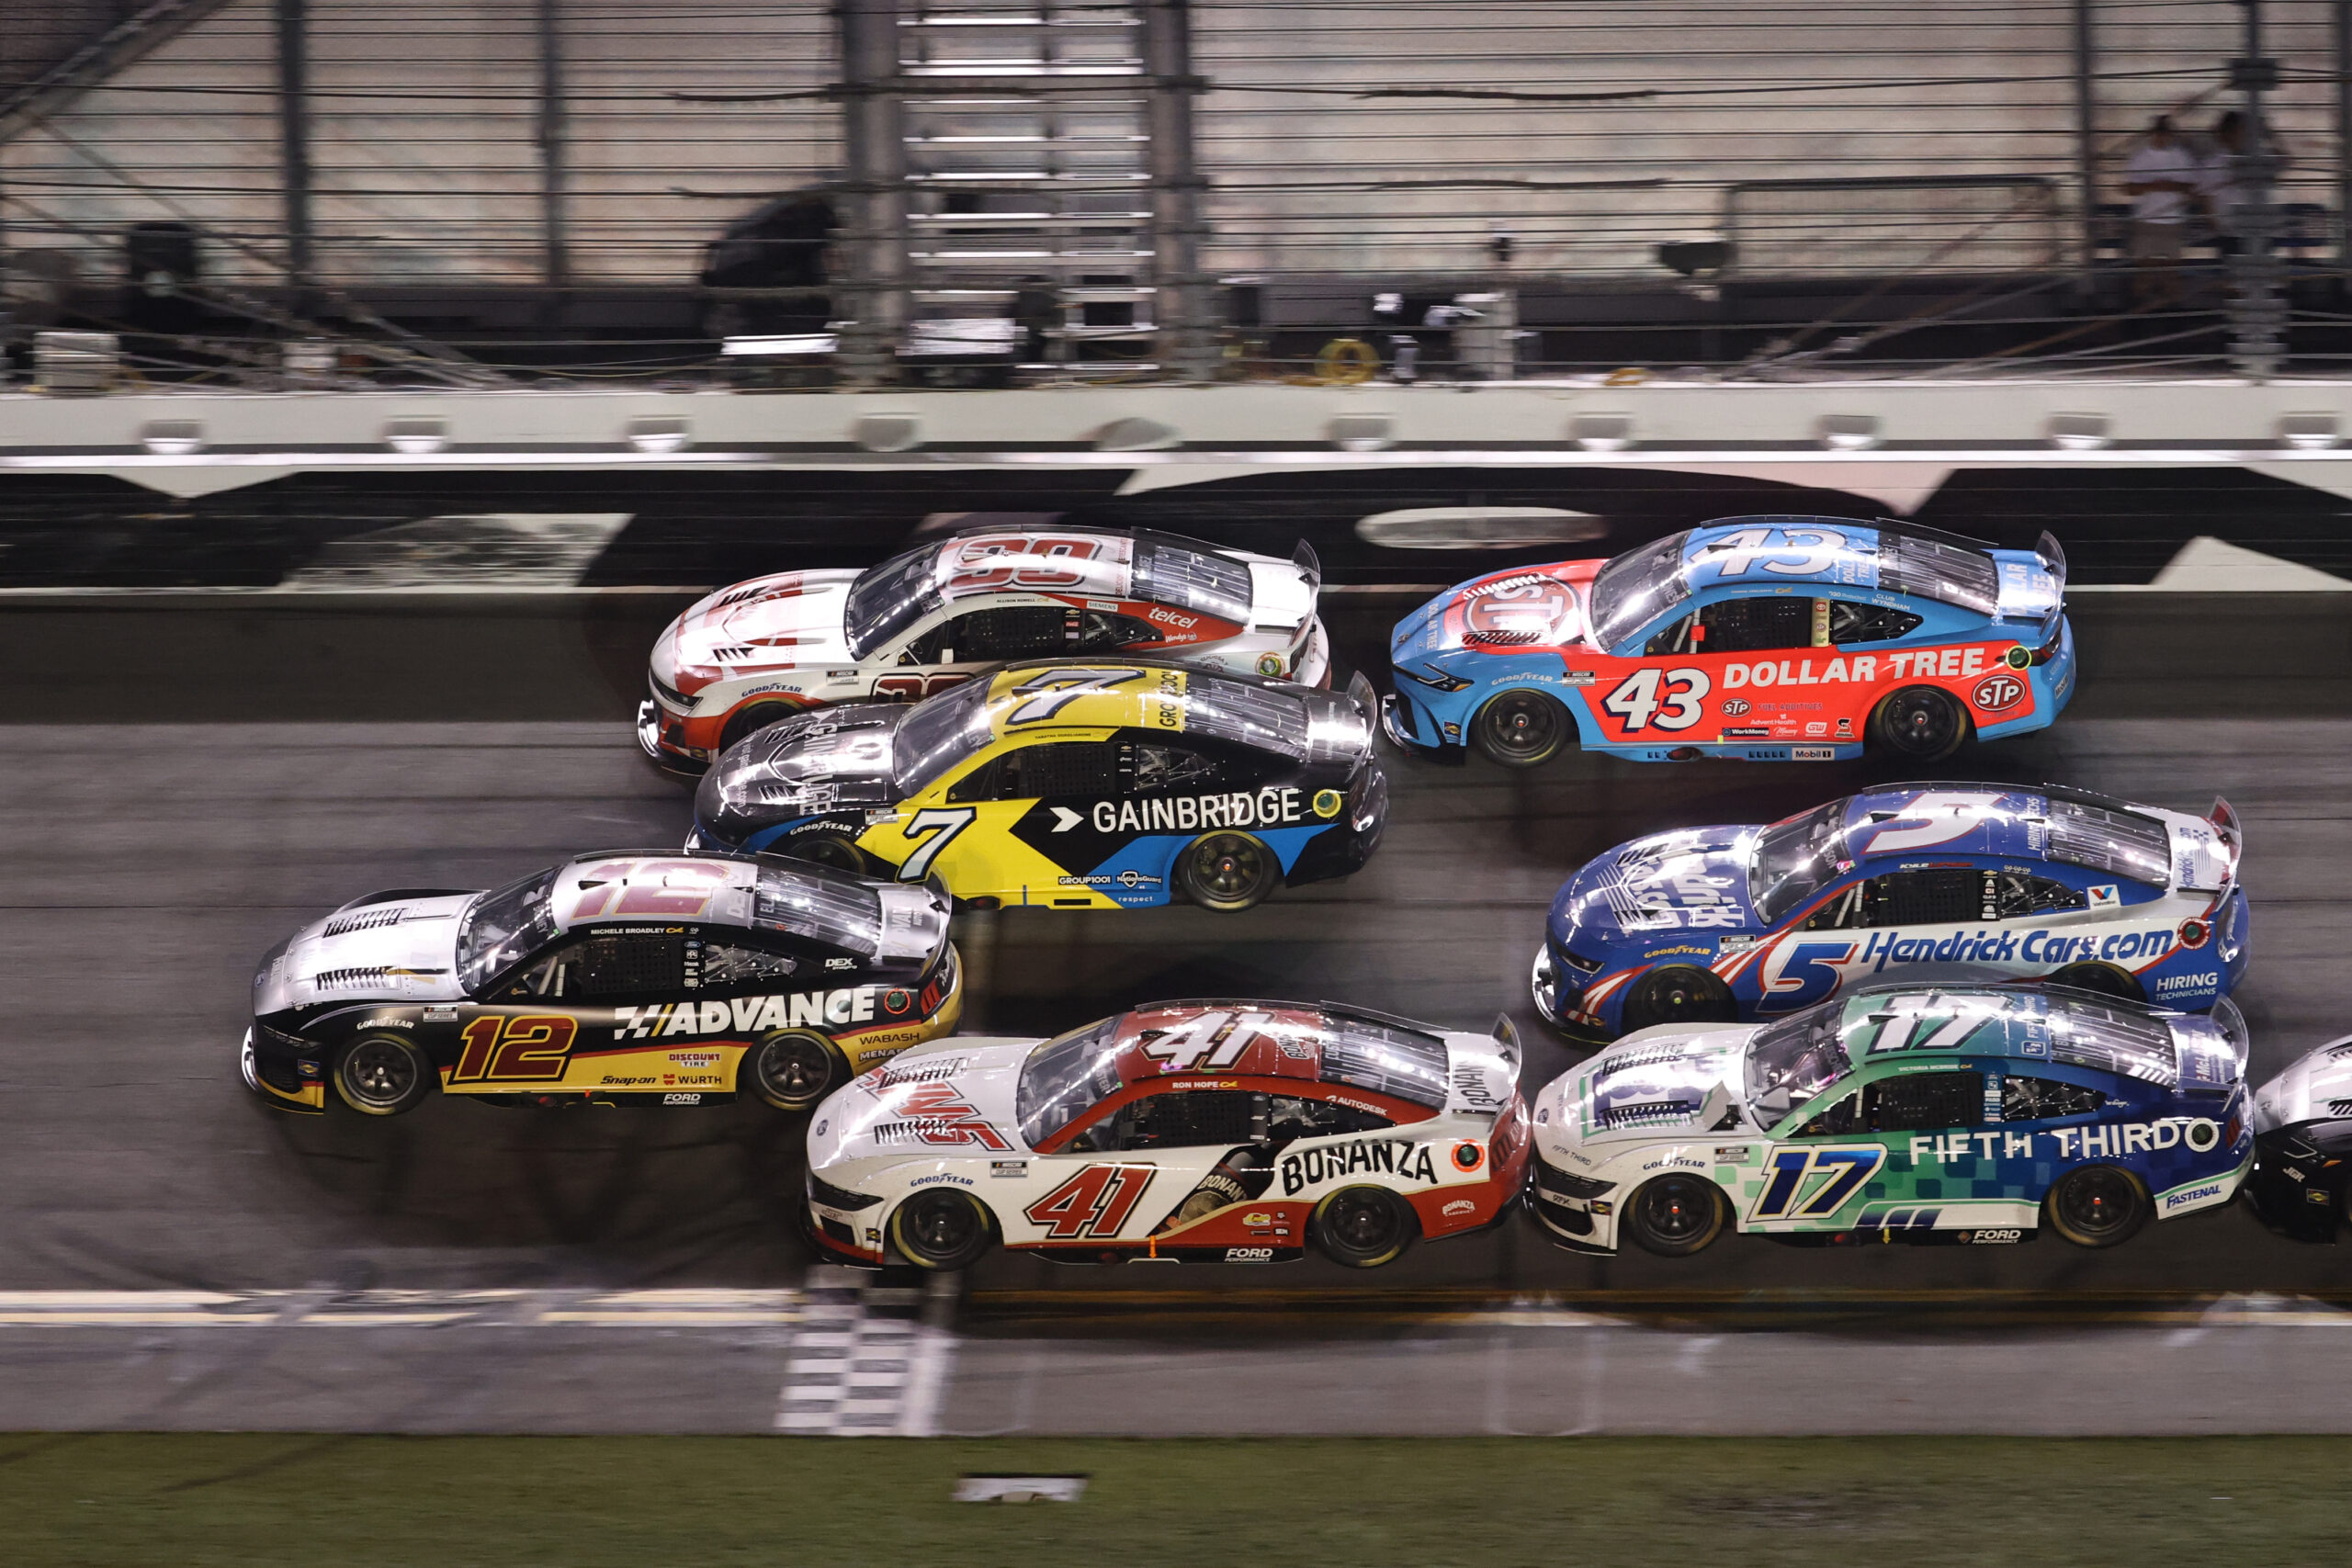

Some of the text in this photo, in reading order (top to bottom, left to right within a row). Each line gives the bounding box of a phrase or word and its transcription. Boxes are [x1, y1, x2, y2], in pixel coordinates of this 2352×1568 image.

[945, 536, 1103, 589] 99
[1690, 528, 1848, 577] 43
[1088, 602, 1117, 611] SIEMENS
[1872, 598, 1911, 611] WYNDHAM
[1148, 606, 1198, 628] telcel
[1426, 630, 1438, 650] TREE
[1491, 671, 1554, 686] GOODYEAR
[1723, 648, 1985, 689] DOLLAR TREE
[741, 682, 803, 698] GOODYEAR
[1004, 669, 1147, 726] 7
[1600, 667, 1712, 734] 43
[1978, 680, 2019, 706] STP
[1724, 700, 1748, 715] STP
[1780, 703, 1823, 711] ADDITIVES
[1795, 750, 1821, 758] Mobil
[1093, 788, 1302, 833] GAINBRIDGE
[790, 820, 853, 835] GOODYEAR
[897, 807, 978, 883] 7
[570, 862, 730, 920] 12
[825, 958, 854, 967] DEX
[1644, 945, 1711, 959] GOODYEAR
[1756, 940, 1860, 1013] 5
[2156, 972, 2219, 991] HIRING
[2155, 987, 2216, 1001] TECHNICIANS
[662, 987, 876, 1036] ADVANCE
[356, 1016, 414, 1031] GOODYEAR
[1865, 995, 2015, 1056] 17
[453, 1014, 579, 1084] 12
[860, 1032, 920, 1045] WABASH
[1139, 1010, 1277, 1071] 41
[858, 1047, 904, 1062] MENA
[600, 1075, 722, 1086] Snap-on WÜRTH
[1453, 1064, 1497, 1107] BONAN
[663, 1093, 701, 1101] FORD
[1337, 1095, 1388, 1116] AUTODESK
[1909, 1120, 2181, 1166] FIFTH THIRD
[1552, 1145, 1592, 1167] FIFTH THIRD
[1282, 1139, 1439, 1196] BONANZA
[910, 1173, 974, 1187] GOODYEAR
[1197, 1175, 1246, 1202] BONAN
[1747, 1143, 1888, 1223] 17
[1023, 1161, 1158, 1240] 41
[2166, 1185, 2222, 1209] FASTENAL
[1442, 1200, 1476, 1216] BONANZA
[1973, 1230, 2021, 1240] FORD
[1226, 1247, 1273, 1258] FORD
